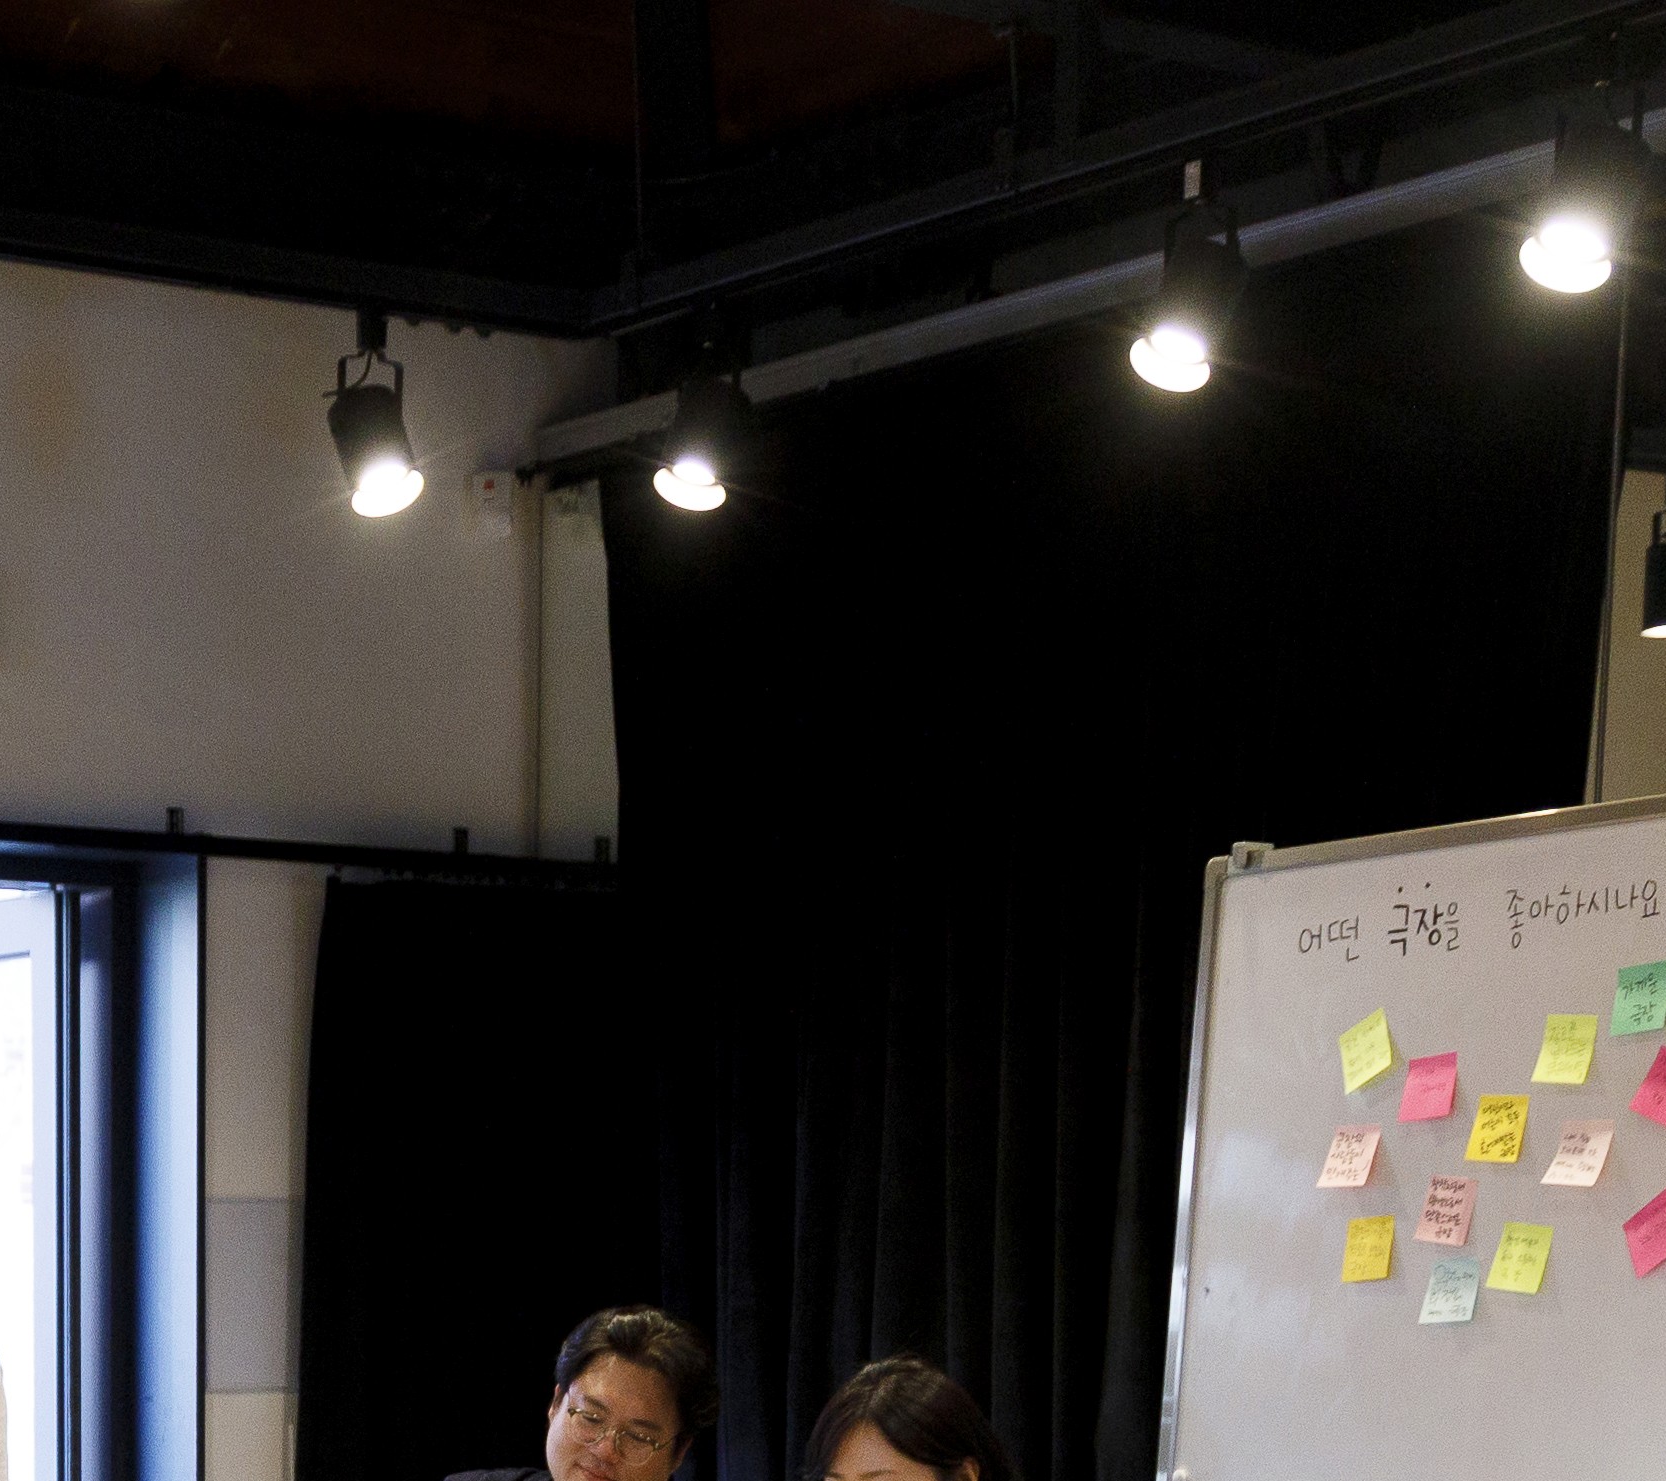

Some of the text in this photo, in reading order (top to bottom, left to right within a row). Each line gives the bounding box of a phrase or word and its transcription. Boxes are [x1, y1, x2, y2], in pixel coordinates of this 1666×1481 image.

[1298, 915, 1360, 962] 어떤
[1388, 902, 1460, 957] 극장을
[1630, 1000, 1658, 1027] 극장
